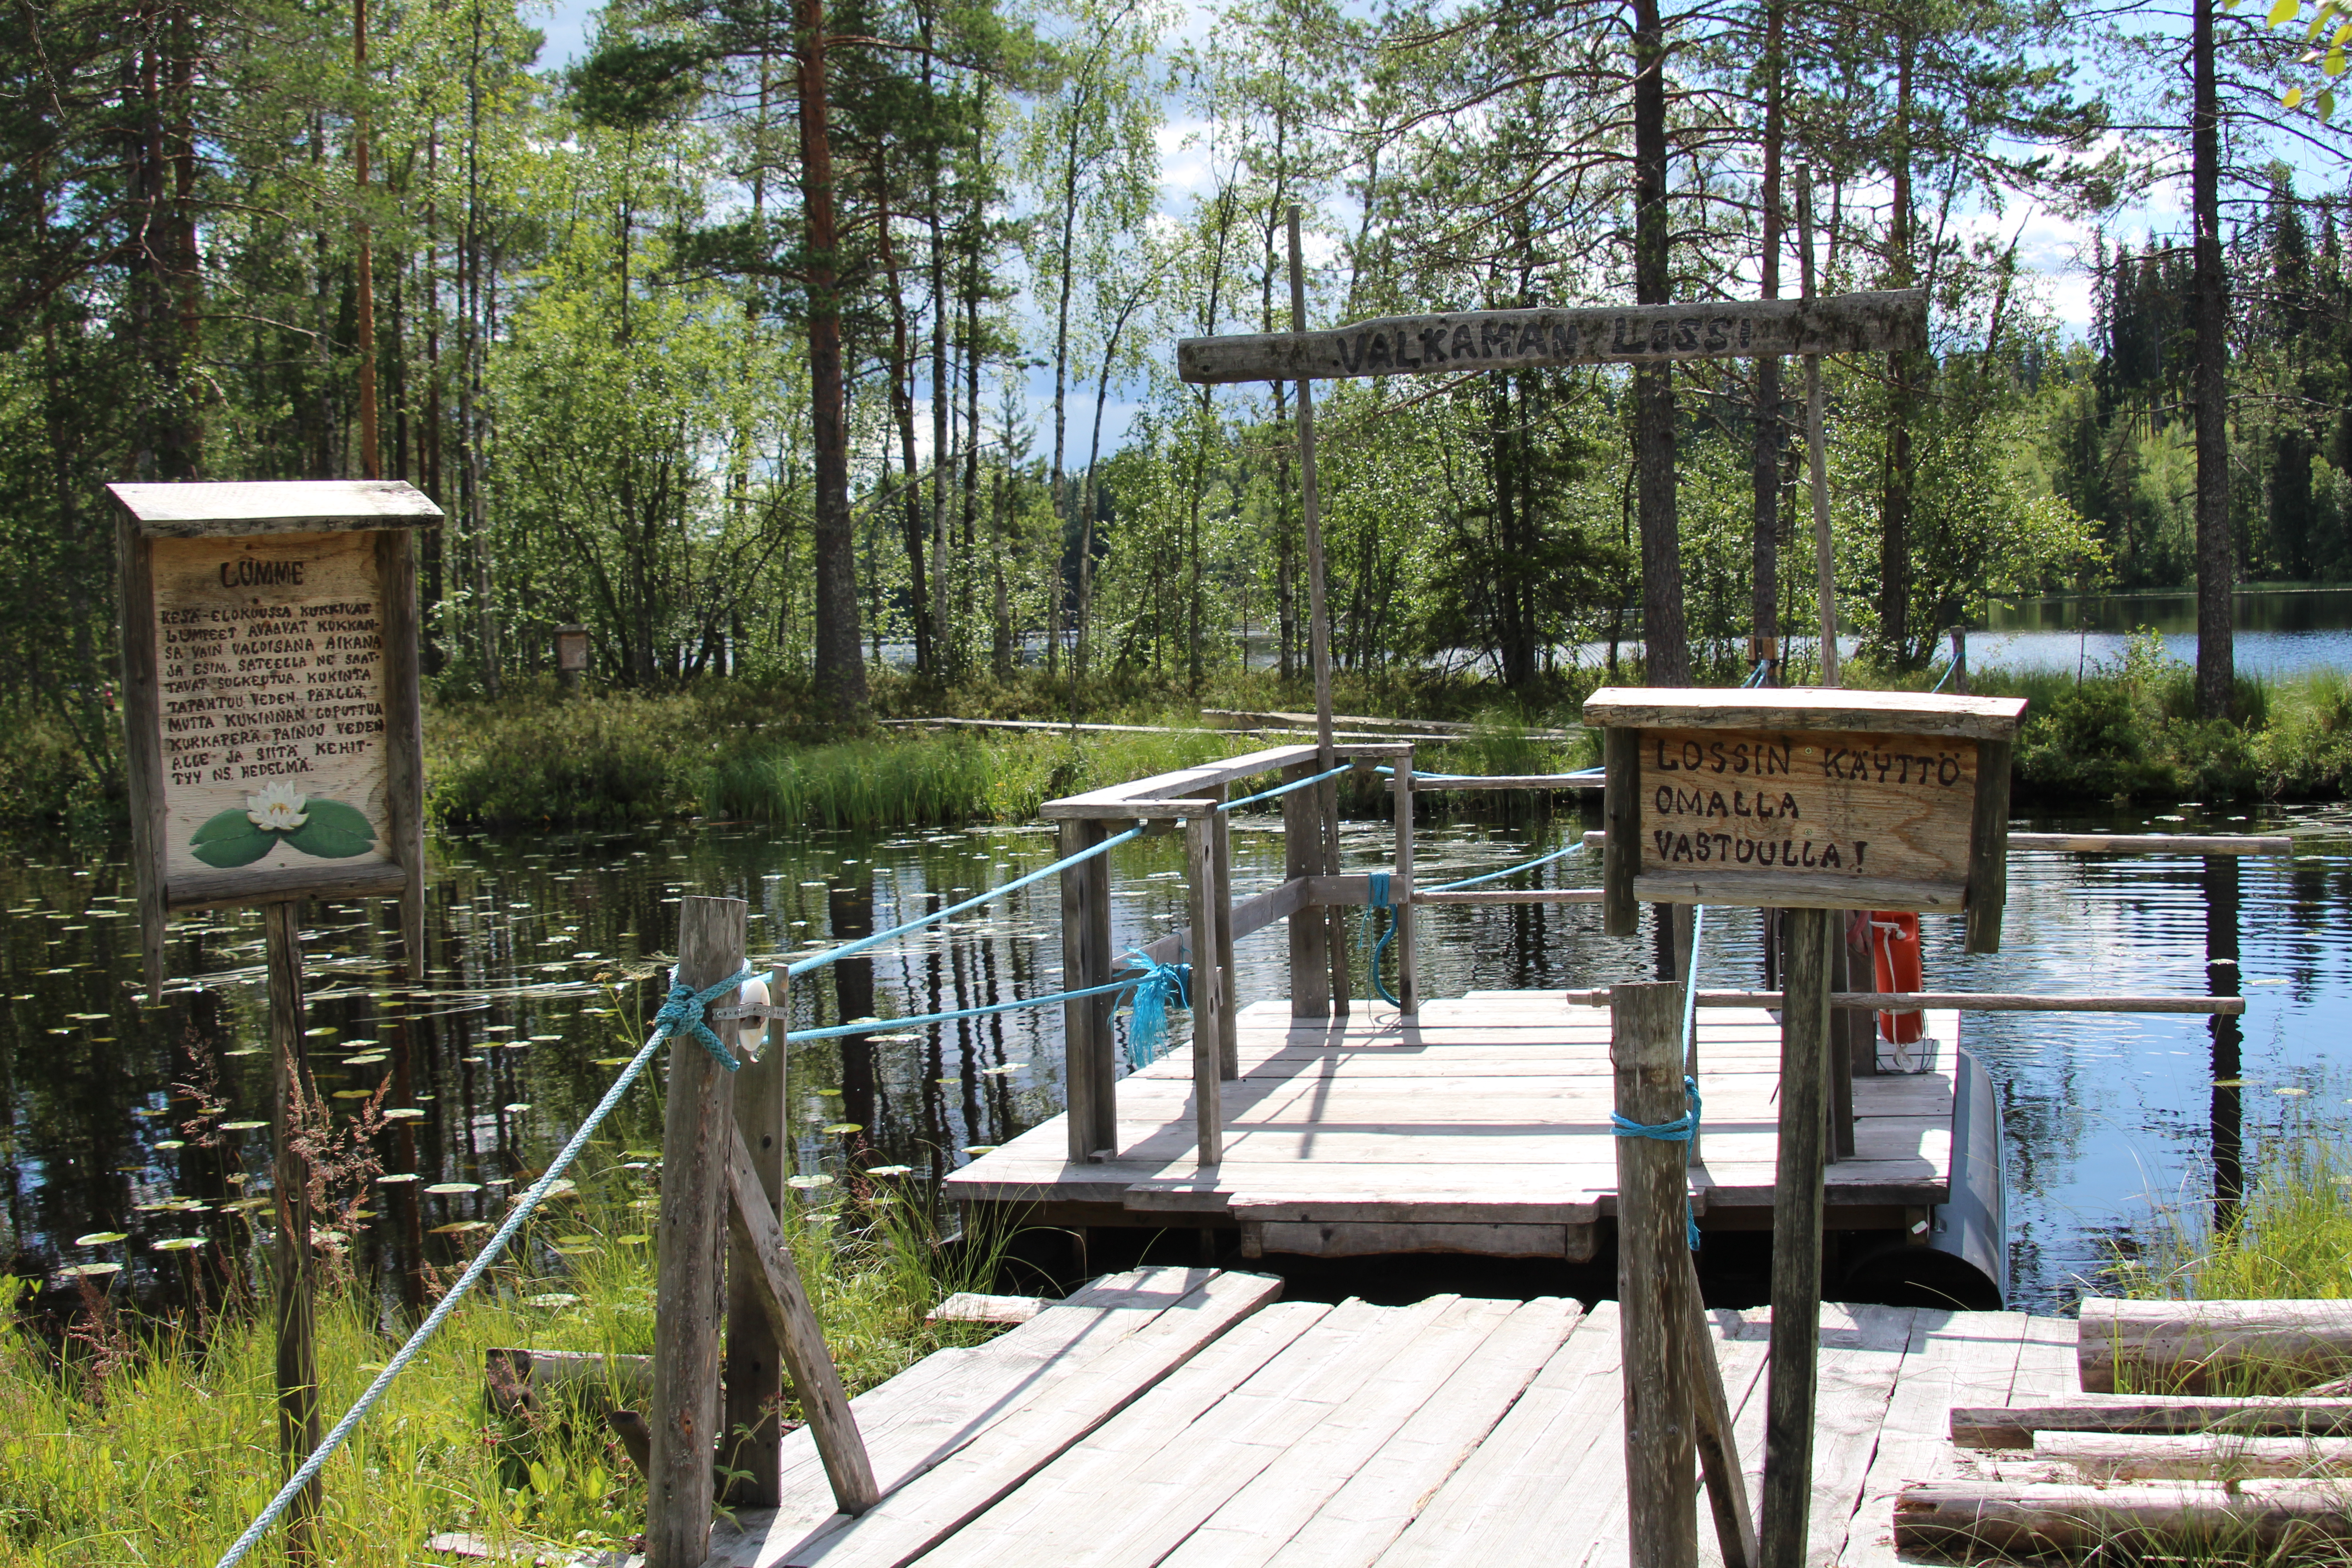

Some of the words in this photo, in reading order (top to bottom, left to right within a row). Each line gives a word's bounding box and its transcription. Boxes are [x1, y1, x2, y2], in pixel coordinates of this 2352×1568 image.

[1336, 323, 1578, 374] VALKAMAN
[1611, 316, 1751, 355] LOSSI
[220, 561, 304, 588] LUMME
[300, 603, 371, 617] KUKKIVAT
[166, 627, 237, 642] LUMPEET
[248, 620, 308, 637] AVAAVAT
[318, 619, 380, 632] KUKKAN-
[165, 646, 184, 659] SA
[192, 644, 223, 658] VAIN
[232, 638, 314, 655] VALOISANA
[325, 636, 382, 649] AIKANA
[167, 664, 183, 677] JA
[193, 662, 231, 675] ESIM.
[238, 657, 306, 671] SATEELLA
[317, 654, 334, 666] NE
[345, 652, 380, 665] SAAT-
[164, 678, 207, 693] TAVAT
[218, 673, 300, 689] SULKEUTUA.
[307, 668, 371, 683] KUKINTA
[167, 696, 243, 713] TAPAHTUU
[250, 691, 295, 705] VEDEN
[306, 686, 366, 701] PÄÄLLÄ,
[168, 715, 215, 732] MUTTA
[224, 708, 305, 727] KUKINNAN
[316, 703, 383, 720] LOPUTTUA
[169, 730, 261, 751] KUKKAPERÄ
[272, 723, 325, 740] PAINUU
[337, 719, 384, 734] VEDEN
[172, 753, 209, 770] ALLE
[226, 750, 244, 763] JA
[257, 745, 298, 760] SIITÄ
[316, 740, 372, 755] KEHIT-
[1656, 740, 1791, 775] LOSSIN
[1823, 747, 1961, 787] KÄYTTÖ
[172, 770, 201, 784] TYY
[213, 767, 233, 781] NS.
[241, 757, 314, 778] HEDELMÄ.
[1655, 785, 1799, 818] OMALLA
